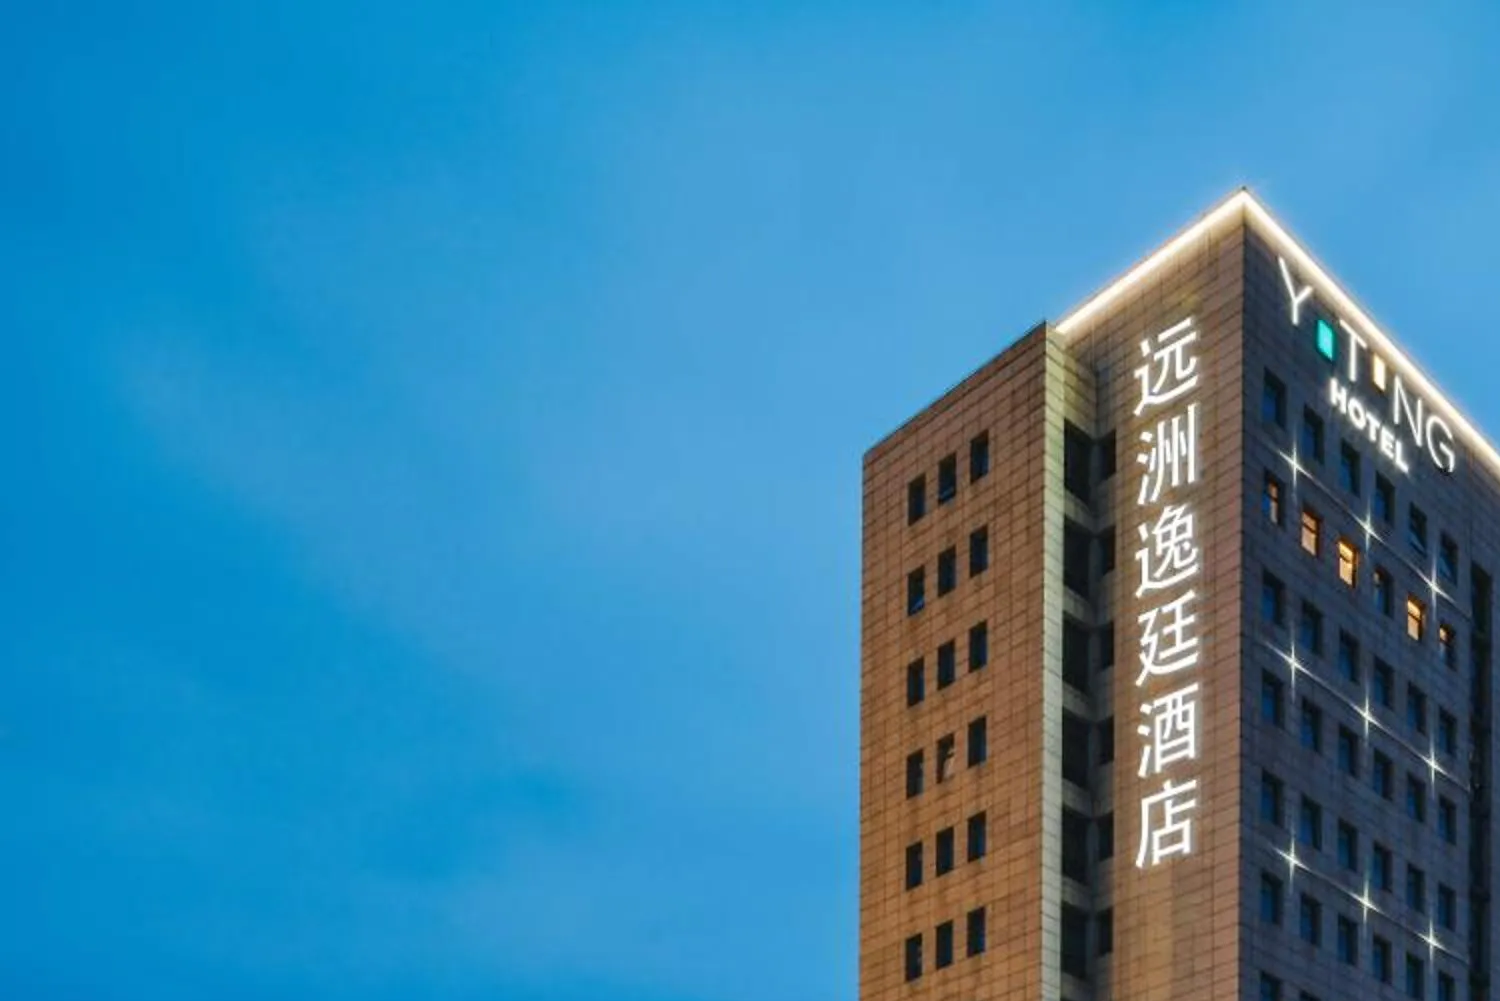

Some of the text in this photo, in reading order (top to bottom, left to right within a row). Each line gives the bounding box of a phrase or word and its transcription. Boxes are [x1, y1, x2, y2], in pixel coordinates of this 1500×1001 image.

[1330, 377, 1409, 474] HOTEL
[1133, 316, 1199, 869] 远洲逸廷酒店
